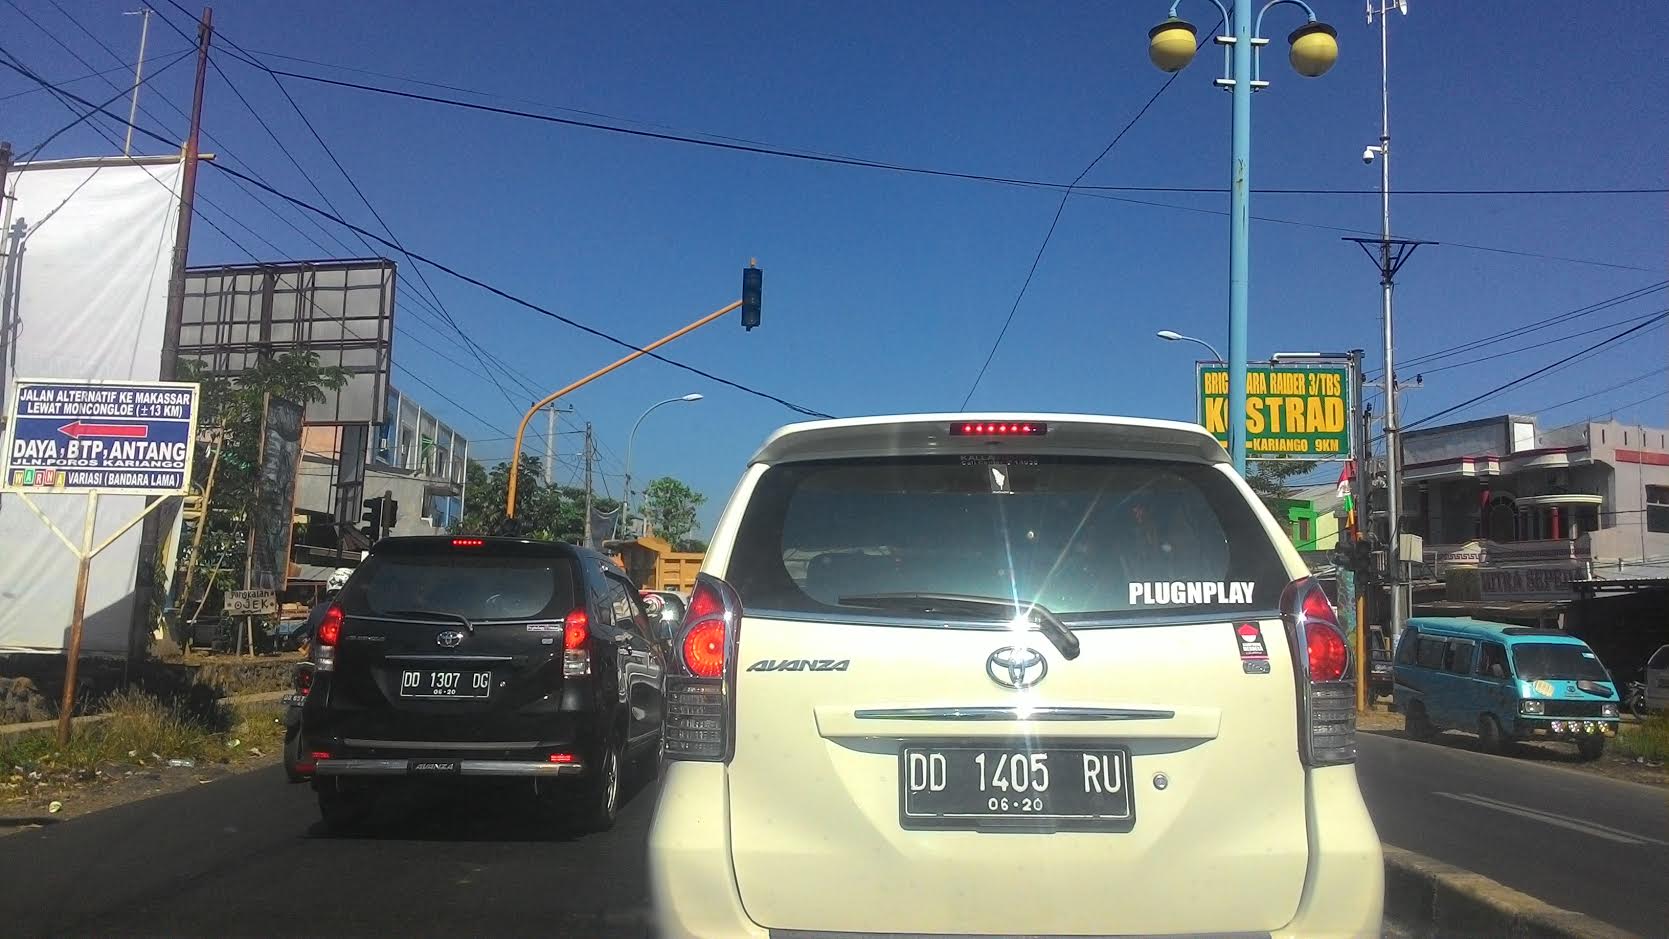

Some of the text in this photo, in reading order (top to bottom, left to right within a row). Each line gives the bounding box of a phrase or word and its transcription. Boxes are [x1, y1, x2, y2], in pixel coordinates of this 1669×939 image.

[1270, 373, 1306, 395] RAIDER
[1308, 373, 1341, 396] 3/TBS
[20, 389, 190, 406] JALAN ALTERNATIF KE MAKASSAR
[27, 402, 62, 414] LEWAT
[63, 403, 134, 416] MONCONGLOE
[164, 406, 183, 418] KM)
[1205, 396, 1345, 434] KSTRAD
[109, 441, 186, 461] ANTANG
[1253, 438, 1339, 452] KARIANGO 9KM
[102, 460, 185, 468] KARIANGO
[13, 469, 180, 487] WARNA VARIASI (BANDARA LAMA)
[1128, 581, 1255, 605] PLUGNPLAY
[746, 659, 851, 673] AVANZA
[404, 672, 489, 689] DD 1307 DG
[910, 752, 1121, 793] DD 1405 RU
